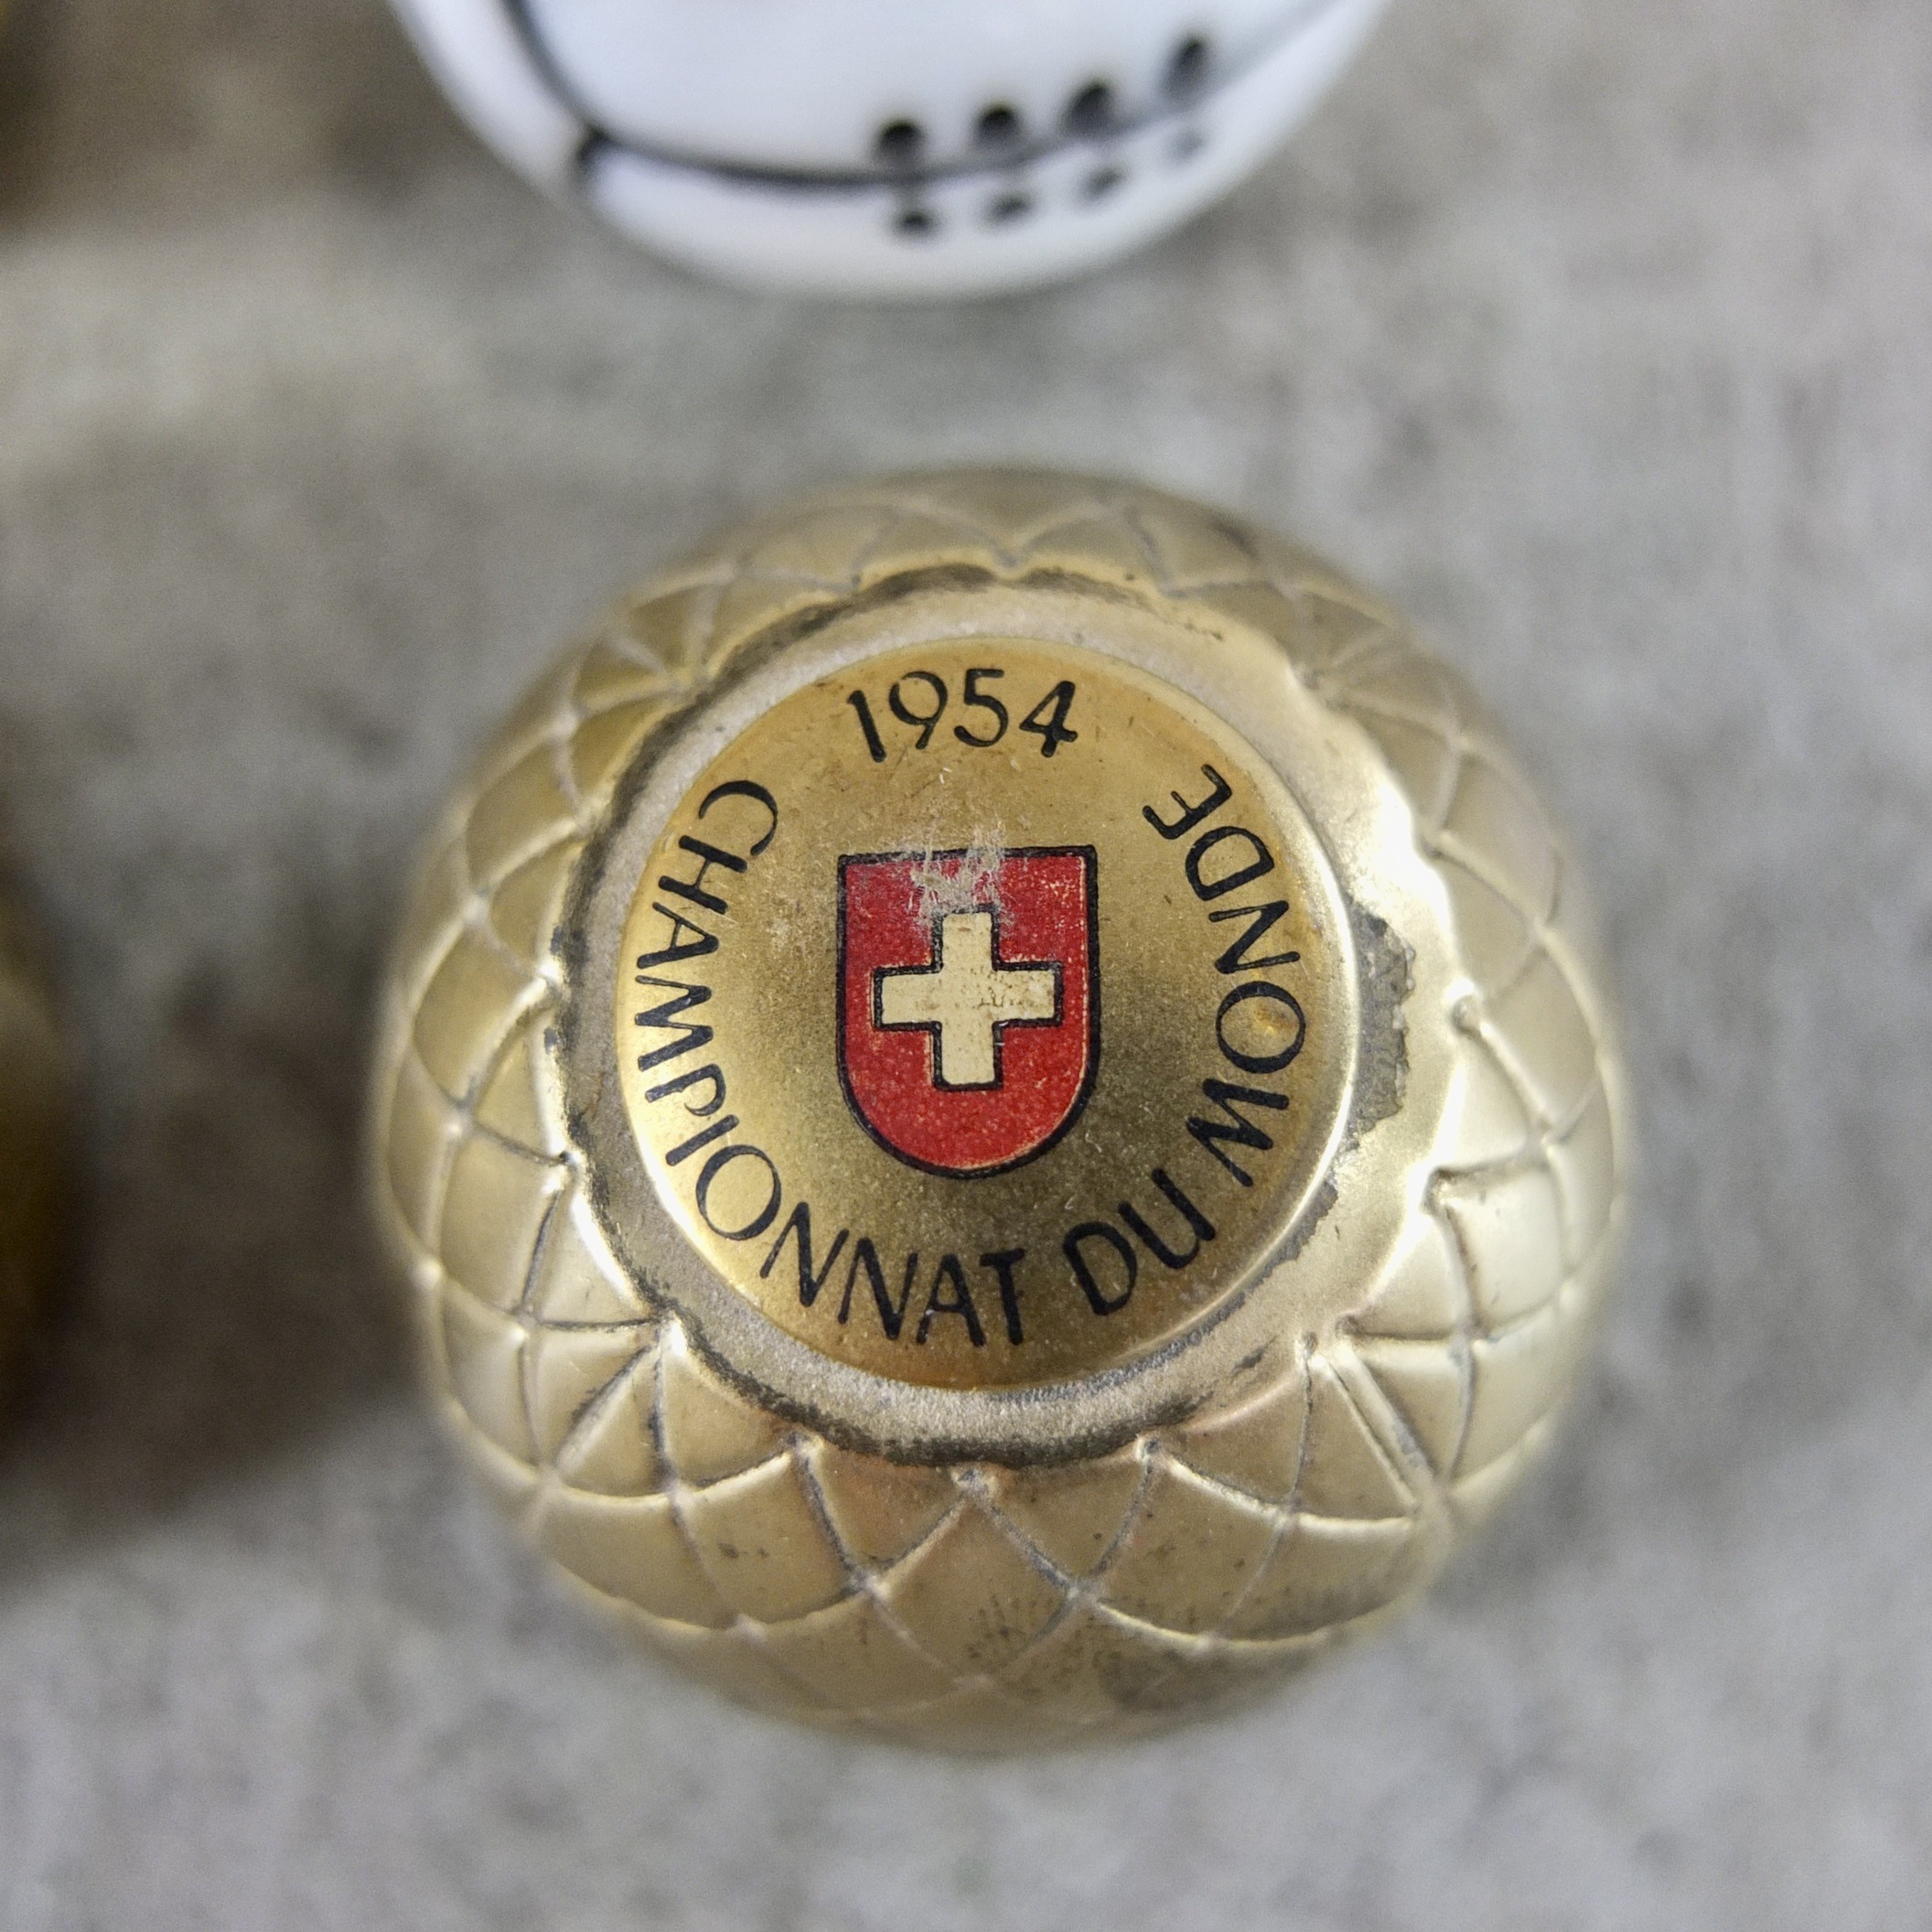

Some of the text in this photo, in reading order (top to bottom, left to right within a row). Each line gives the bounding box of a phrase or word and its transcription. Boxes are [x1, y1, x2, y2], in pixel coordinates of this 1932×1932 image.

[847, 667, 1079, 762] 1954
[634, 763, 1306, 1347] CHAMPIONNAT DU MONDE
